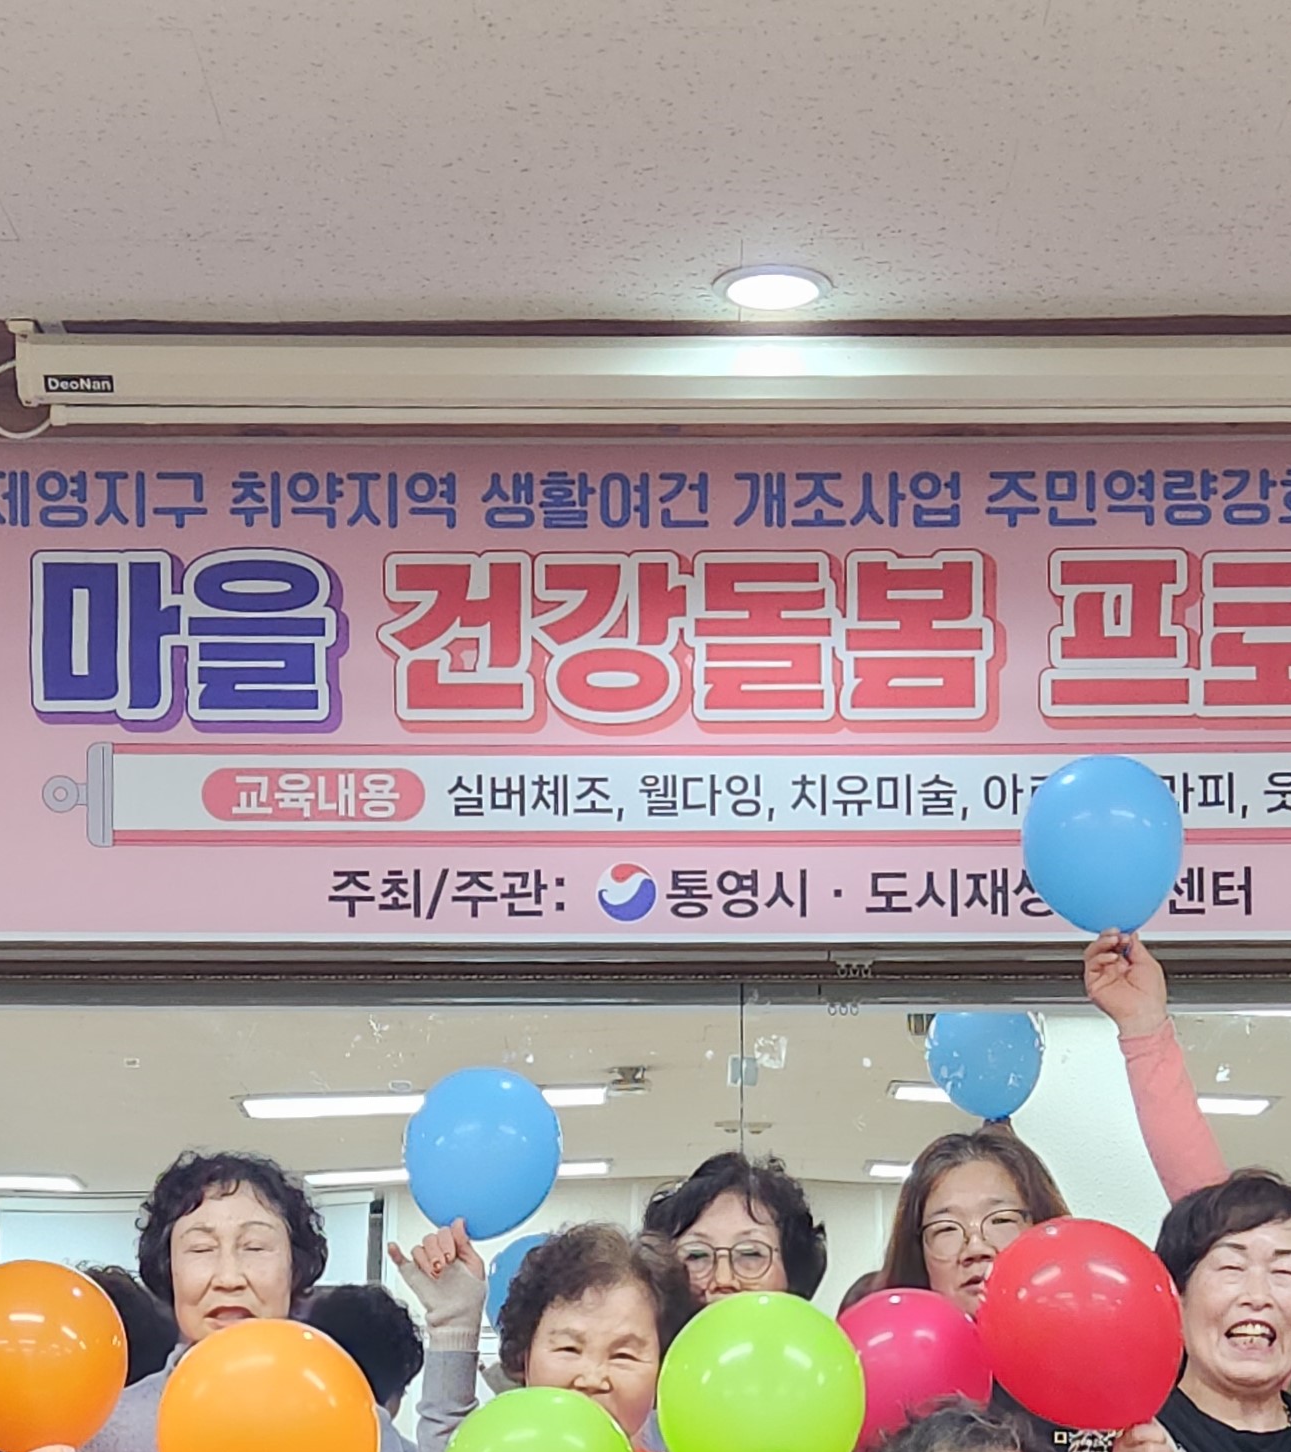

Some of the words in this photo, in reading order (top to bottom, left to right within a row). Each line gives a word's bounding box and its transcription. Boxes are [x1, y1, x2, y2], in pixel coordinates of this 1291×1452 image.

[230, 471, 456, 529] 취약지역
[482, 472, 708, 529] 생활여건
[735, 472, 961, 529] 개조사업
[30, 548, 337, 722] 마을
[379, 547, 993, 722] 건강돌봄
[231, 772, 401, 819] 교육내용
[448, 774, 625, 821] 실버체조,
[640, 774, 776, 820] 웰다잉,
[791, 774, 969, 821] 치유미술,
[328, 867, 567, 920] 주최/주관:
[665, 868, 808, 918] 통영시
